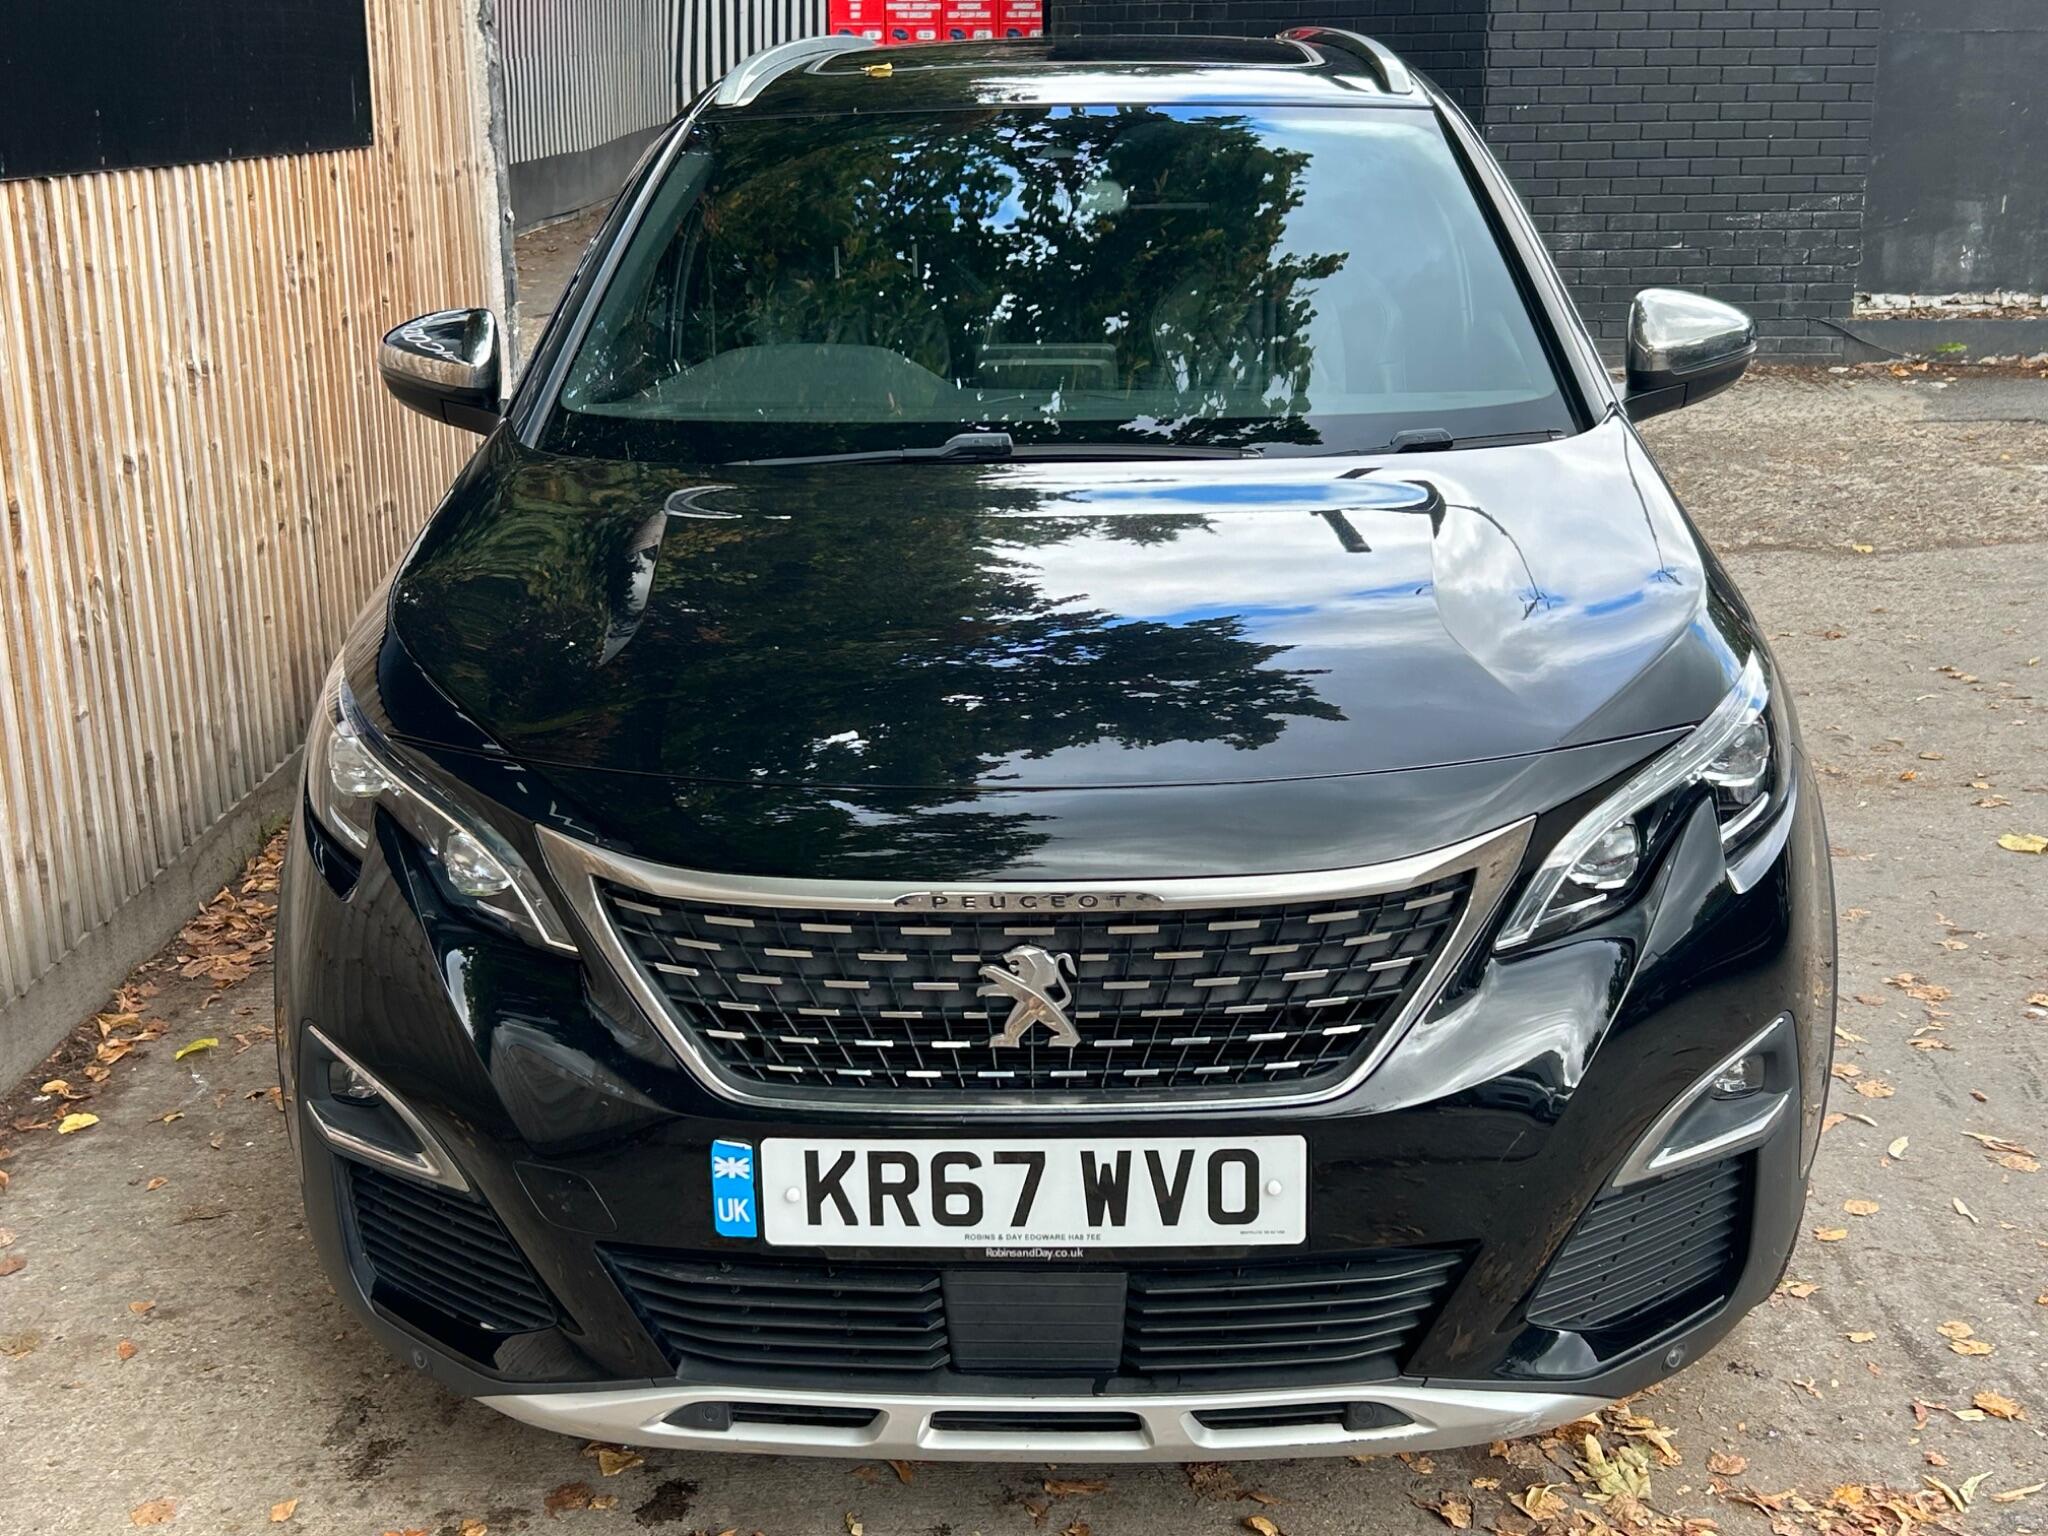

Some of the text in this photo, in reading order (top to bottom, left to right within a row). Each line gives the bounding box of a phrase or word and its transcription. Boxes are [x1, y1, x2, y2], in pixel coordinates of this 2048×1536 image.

[931, 894, 1126, 910] PEUGEOT
[803, 1148, 1260, 1227] KR67 WVO
[717, 1197, 751, 1223] UK
[964, 1233, 1101, 1241] ROBINS & DAY EDGWARE HA8 7EE
[985, 1247, 1084, 1261] RobinsandDay.co.uk
